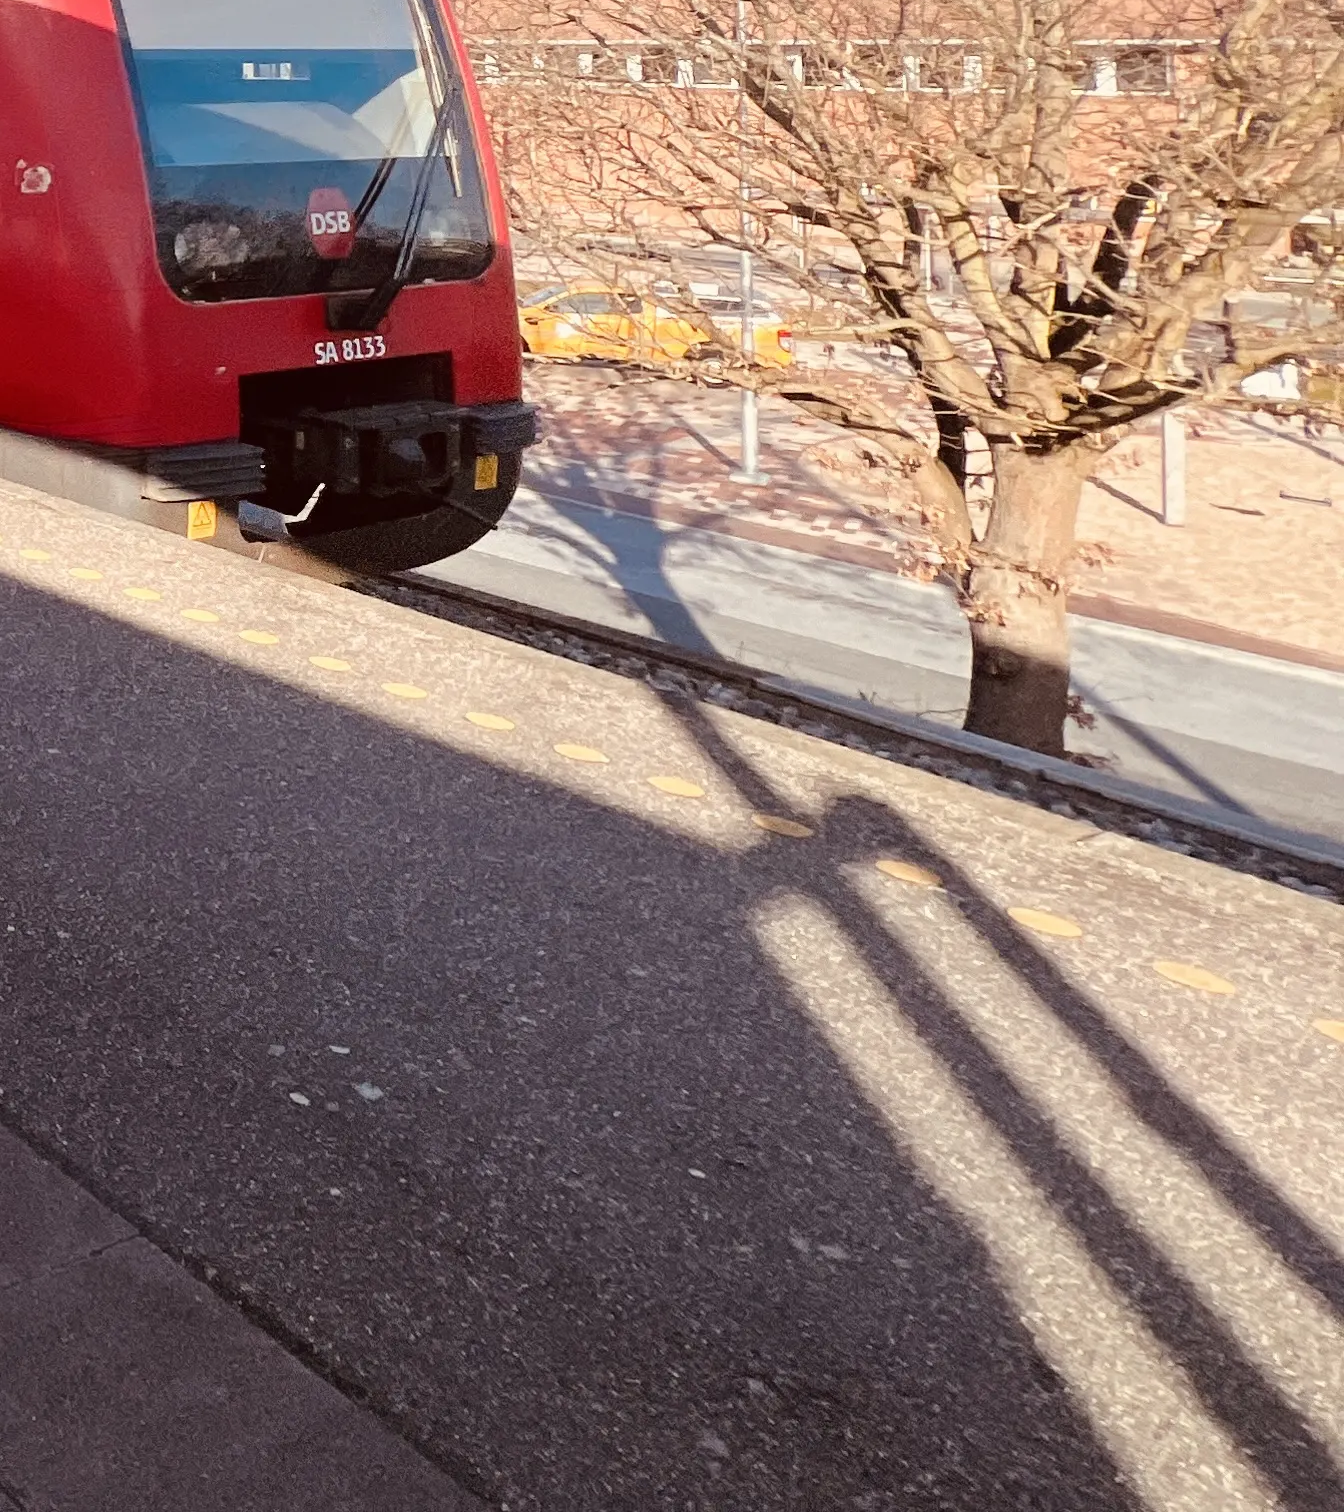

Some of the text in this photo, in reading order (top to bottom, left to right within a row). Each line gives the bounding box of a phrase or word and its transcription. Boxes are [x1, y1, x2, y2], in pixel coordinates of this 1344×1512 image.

[310, 210, 351, 236] DSB
[314, 335, 387, 365] SA 8133
